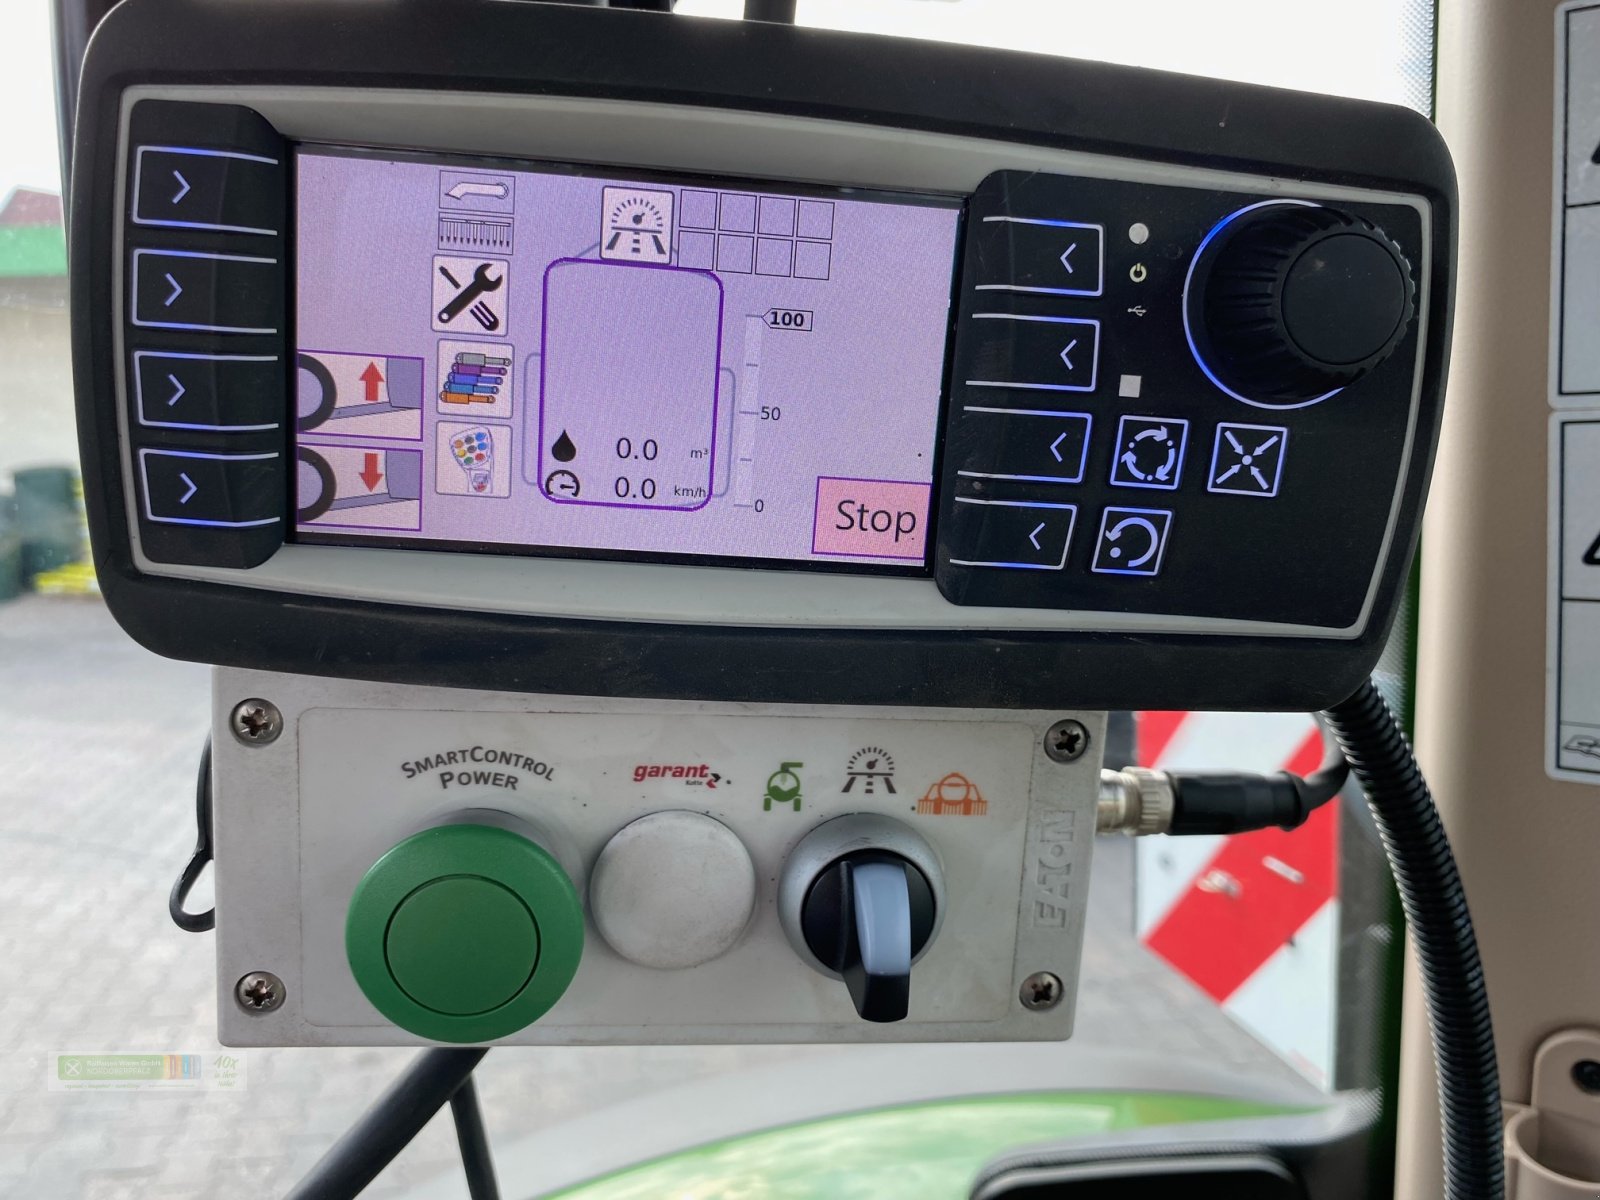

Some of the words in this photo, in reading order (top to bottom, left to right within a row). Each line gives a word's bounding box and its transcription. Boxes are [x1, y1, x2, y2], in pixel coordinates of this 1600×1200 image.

[769, 310, 805, 328] 100
[760, 406, 781, 422] 50
[616, 437, 659, 461] 0.0
[614, 476, 657, 500] 0.0
[673, 484, 707, 499] km/h
[753, 499, 764, 513] 0
[835, 499, 917, 541] Stop
[438, 771, 519, 791] POWER
[632, 763, 710, 782] garant
